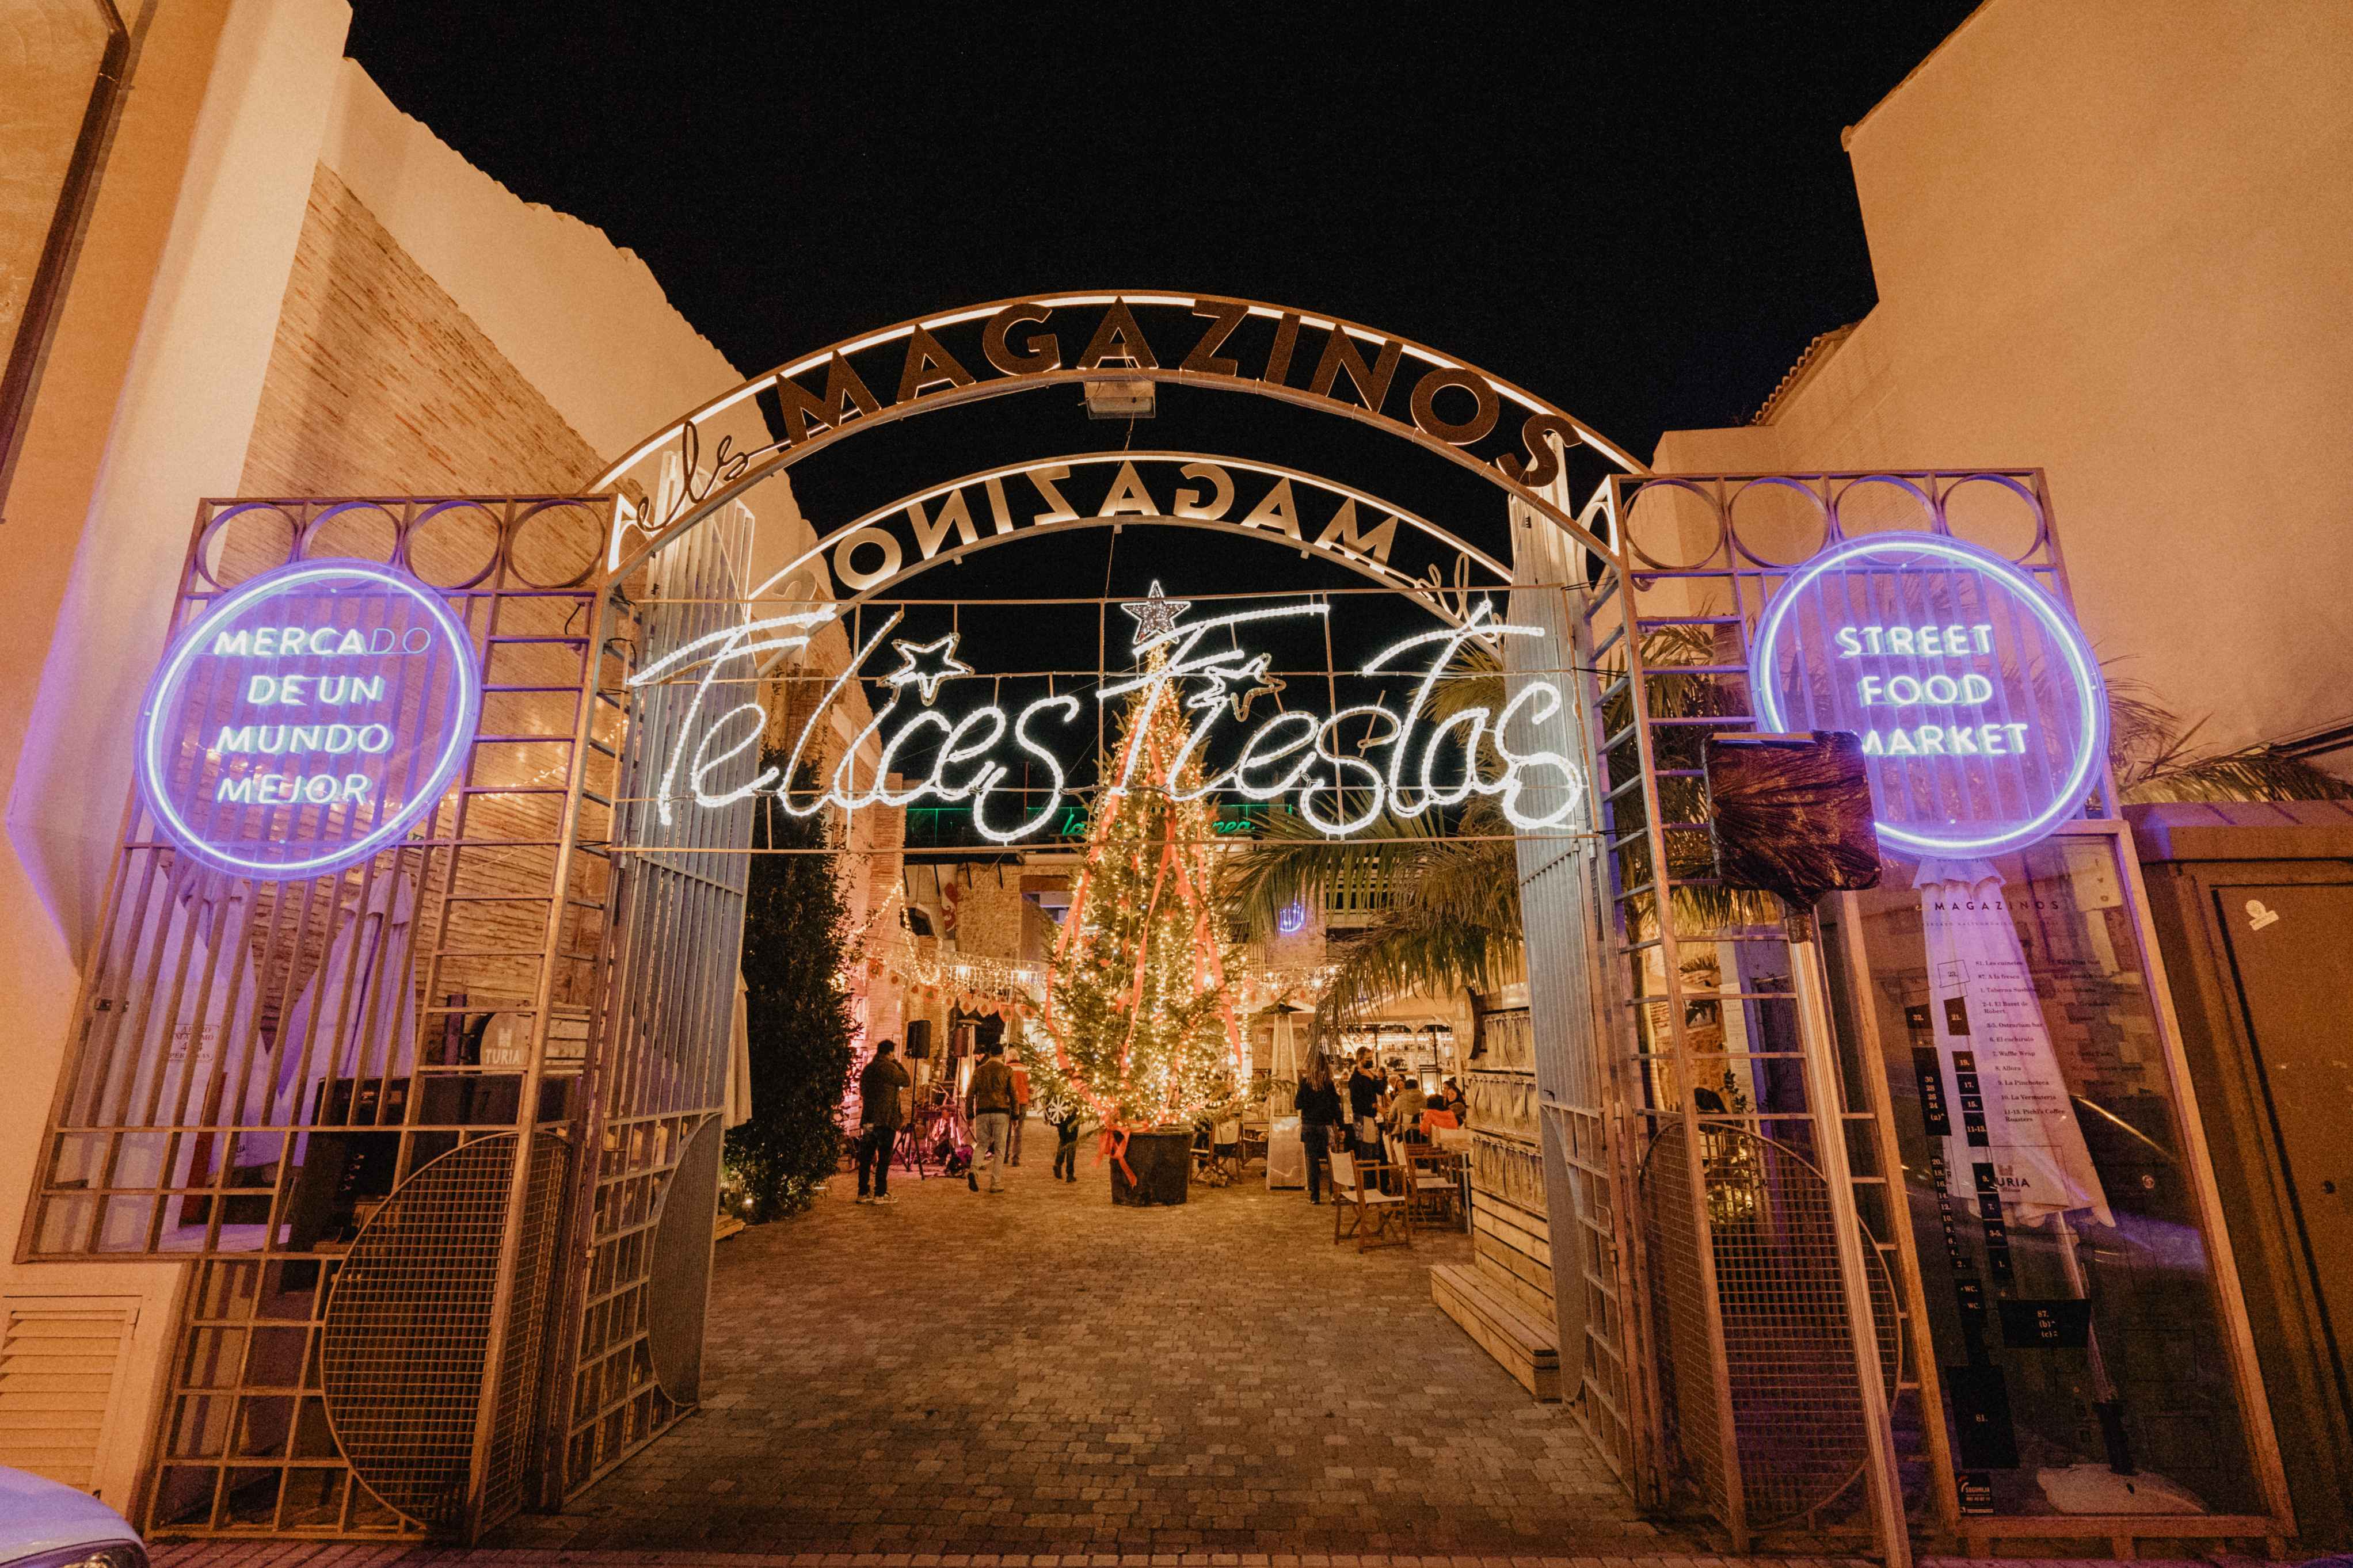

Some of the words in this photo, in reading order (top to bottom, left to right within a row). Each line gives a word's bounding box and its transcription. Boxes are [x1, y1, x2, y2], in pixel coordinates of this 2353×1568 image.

[776, 296, 1583, 487] MAGAZINOS
[213, 627, 432, 657] MERCADO
[1837, 625, 1992, 657] STREET
[248, 674, 306, 705] DE
[318, 674, 382, 704] UN
[1861, 674, 1993, 707] FOOD
[627, 603, 1080, 844] Felices
[1096, 600, 1584, 835] Fiestas
[215, 723, 391, 754] MUNDO
[1862, 724, 2028, 756] MARKET
[217, 774, 372, 805] MEJOR
[1935, 901, 2059, 910] MAGAZINOS
[485, 1048, 520, 1065] TURIA
[1996, 1177, 2030, 1188] URIA
[1975, 1413, 1989, 1422] 81.
